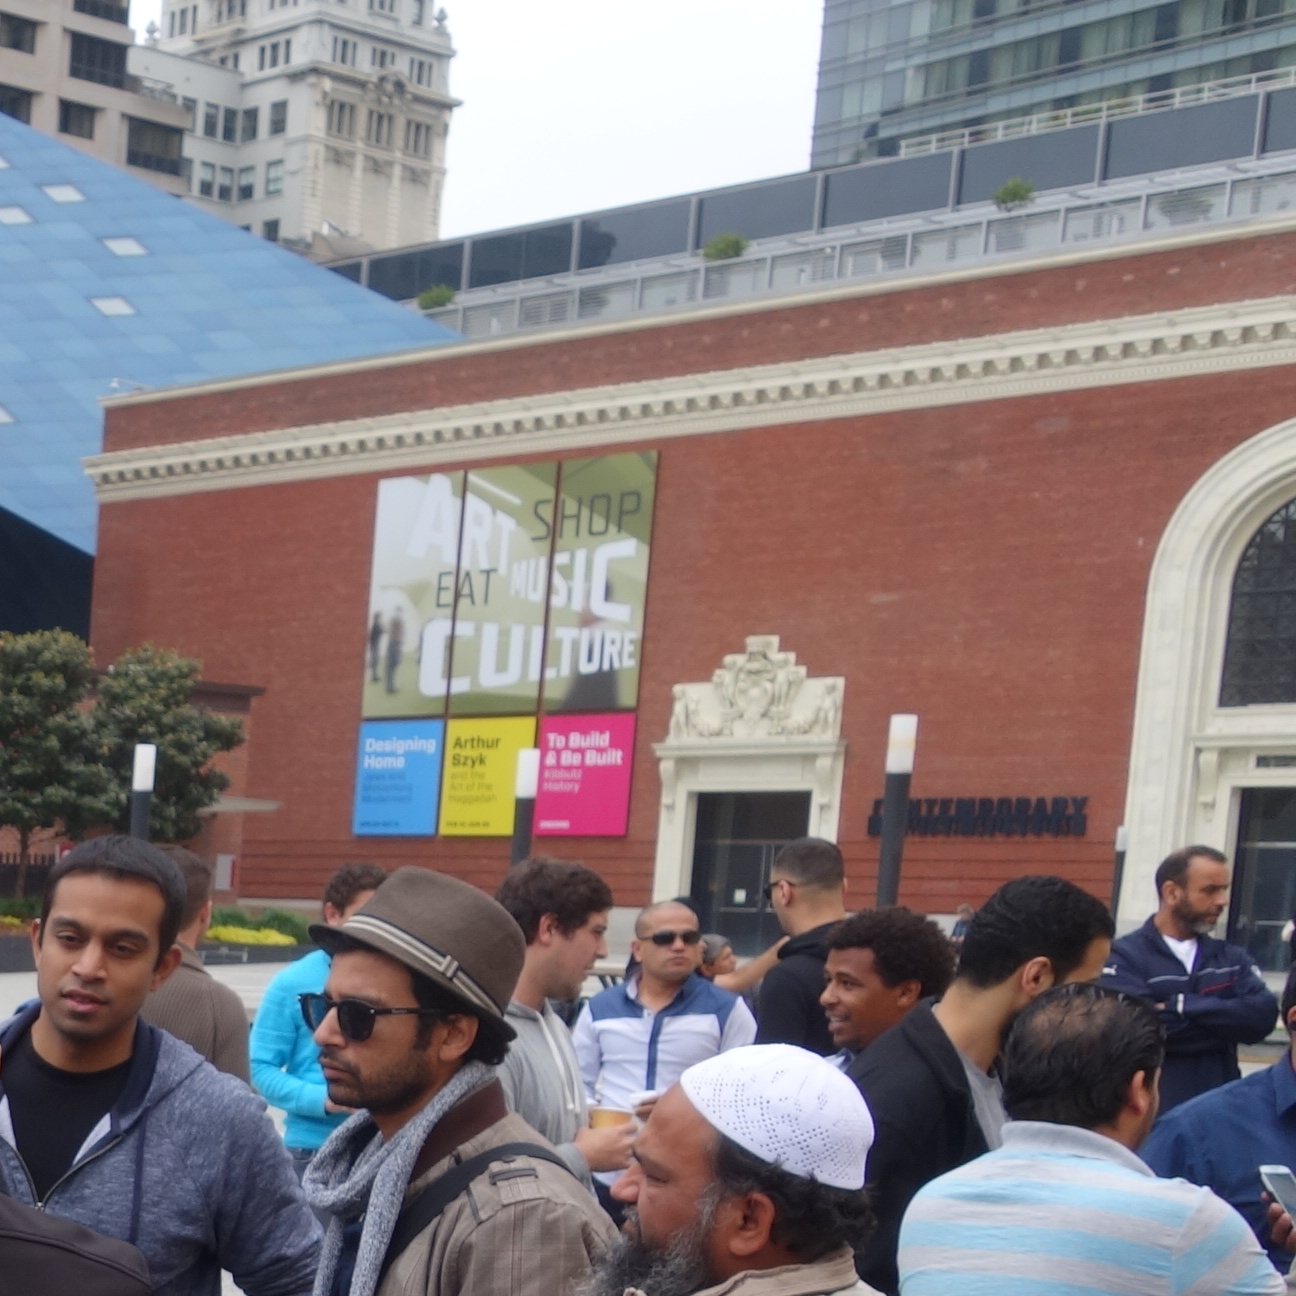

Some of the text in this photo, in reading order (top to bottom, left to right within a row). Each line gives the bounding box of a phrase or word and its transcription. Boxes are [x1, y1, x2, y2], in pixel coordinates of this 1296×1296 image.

[408, 472, 518, 576] ART
[531, 490, 642, 541] SHOP
[436, 568, 497, 607] EAT
[511, 537, 638, 623] MUSIC
[419, 617, 638, 696] CULTURE
[365, 736, 436, 755] Designing
[453, 736, 501, 749] Arthur
[546, 730, 610, 749] To Build
[364, 754, 405, 769] Home
[452, 752, 487, 769] Szyk
[560, 749, 582, 767] Be
[584, 748, 623, 767] Built
